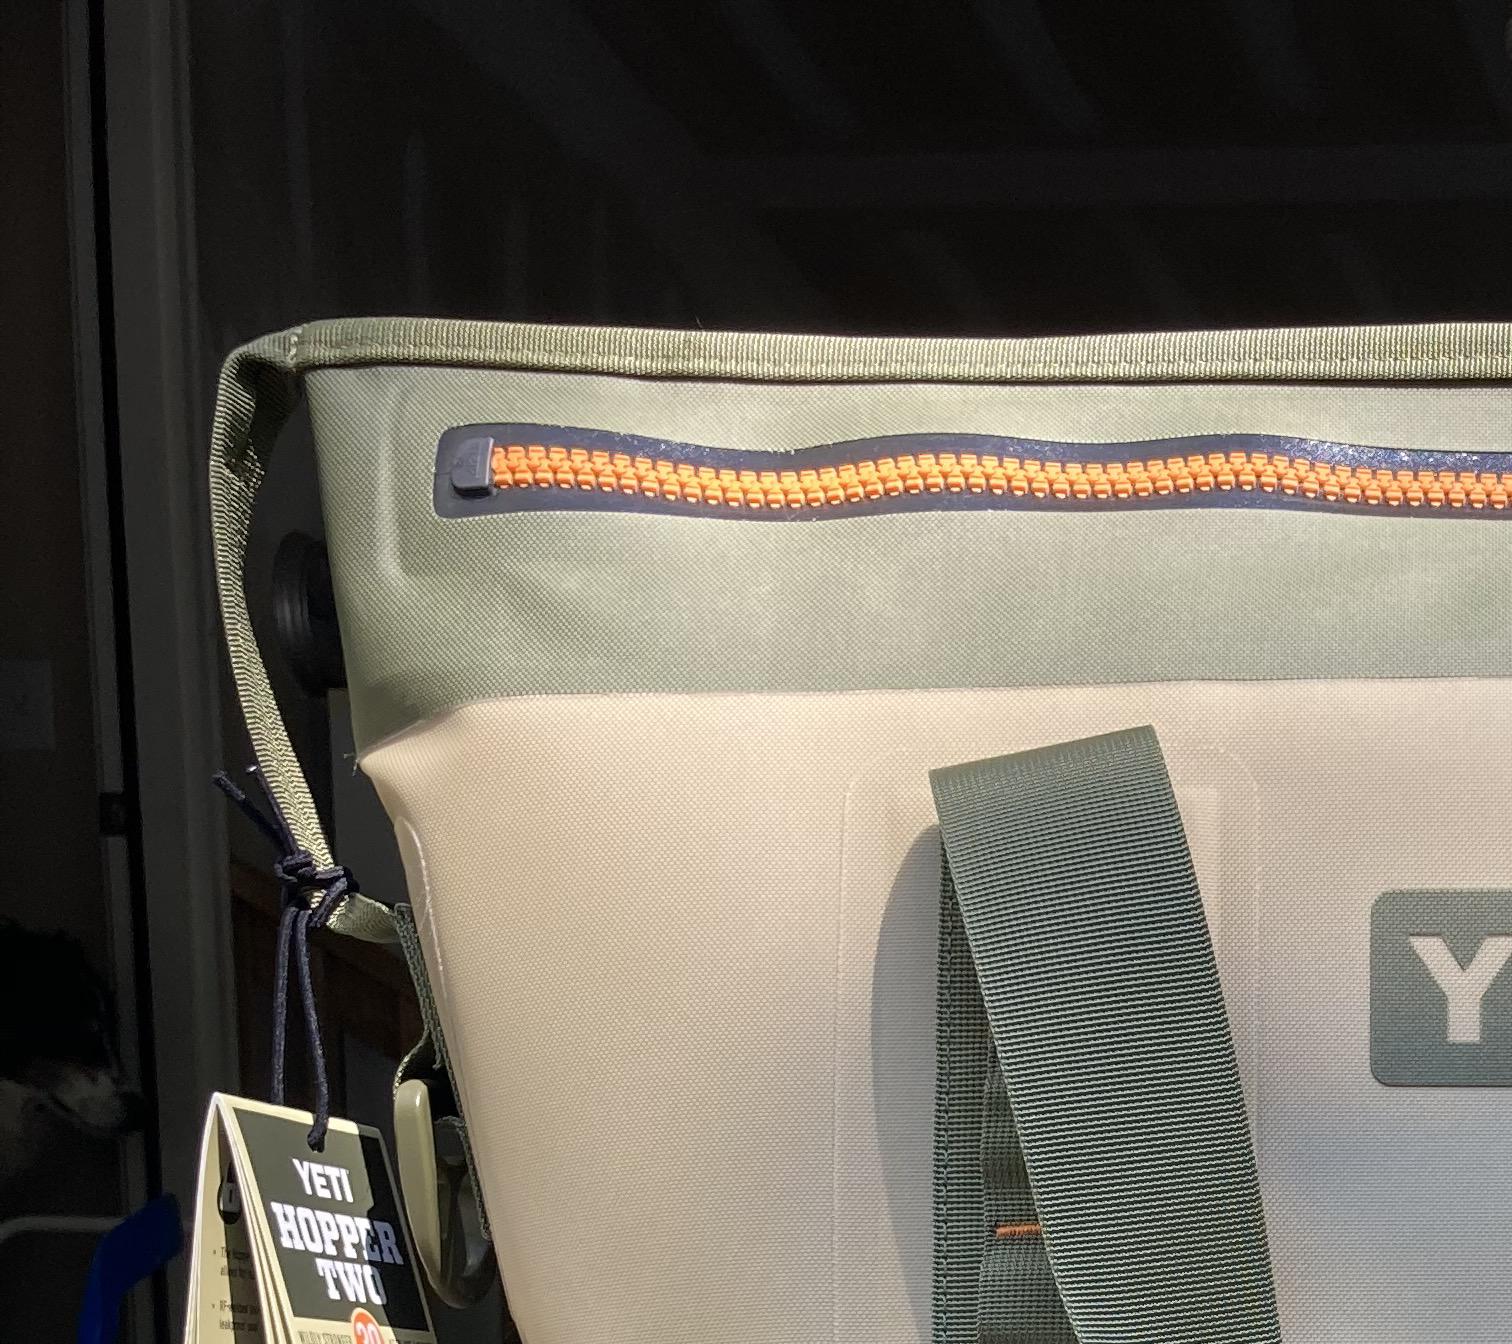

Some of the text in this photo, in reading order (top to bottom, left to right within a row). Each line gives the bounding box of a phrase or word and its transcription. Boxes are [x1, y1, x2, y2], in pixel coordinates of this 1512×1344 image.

[291, 1157, 354, 1203] YETI
[270, 1201, 404, 1265] HOPPER
[315, 1257, 387, 1305] TWO
